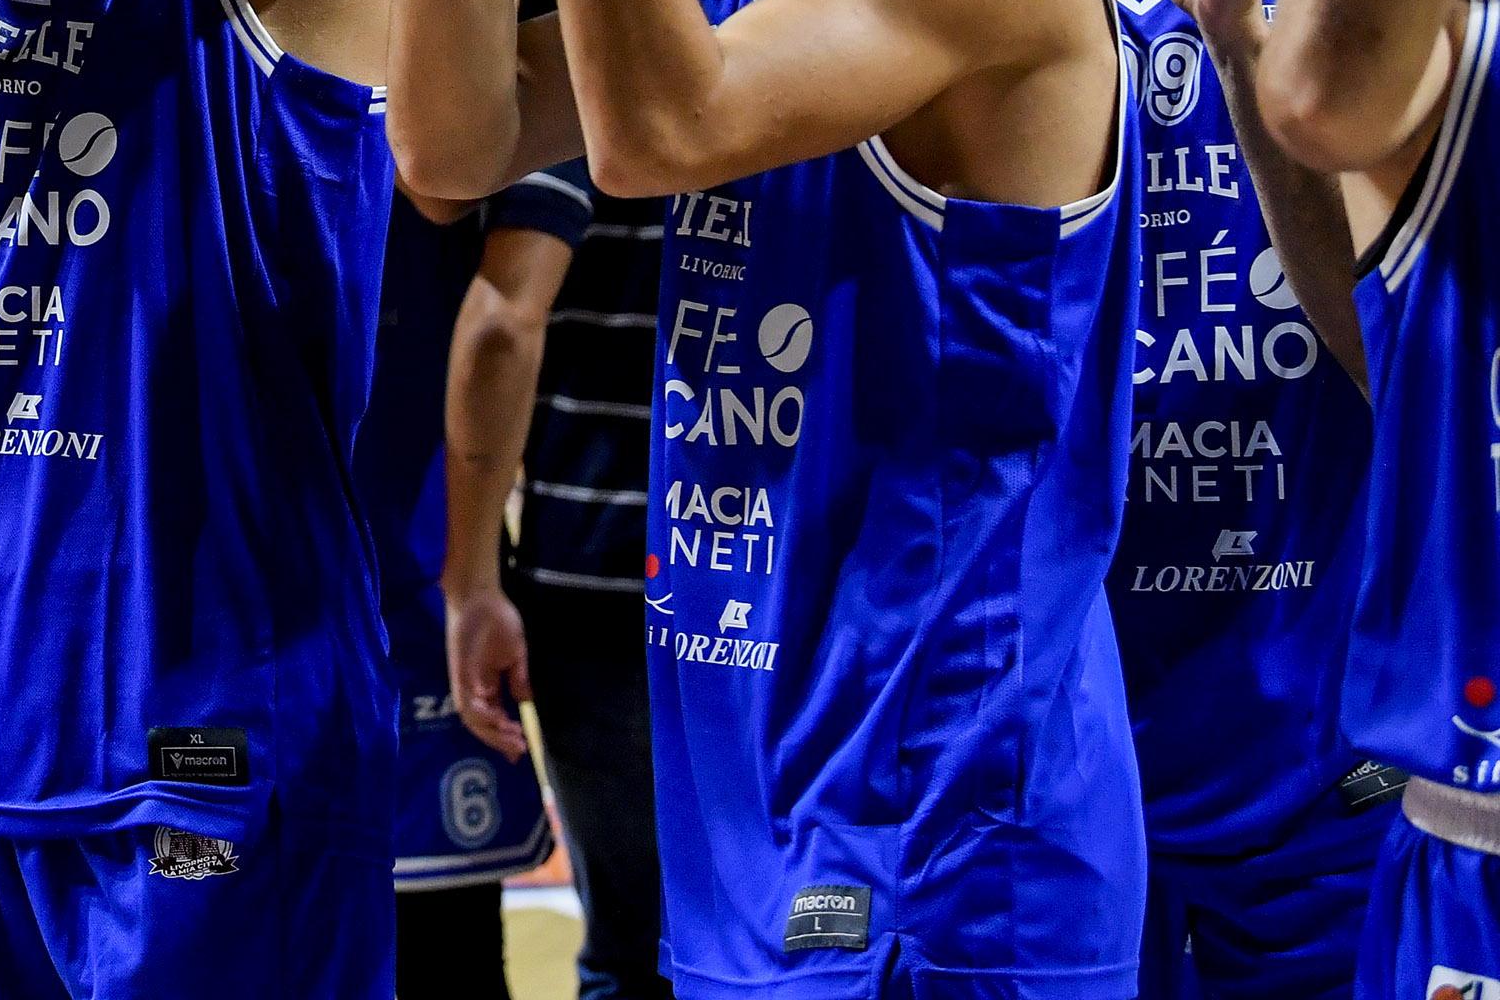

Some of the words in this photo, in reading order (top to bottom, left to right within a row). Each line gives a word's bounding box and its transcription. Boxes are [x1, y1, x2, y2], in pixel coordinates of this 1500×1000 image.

[669, 526, 774, 576] NETI
[1130, 560, 1316, 593] LORENZONI
[190, 734, 205, 744] XL
[185, 755, 227, 766] macron
[1377, 776, 1389, 787] L
[440, 757, 502, 849] 6
[170, 856, 210, 870] LIVORNO
[794, 894, 856, 913] macron
[814, 917, 822, 931] L
